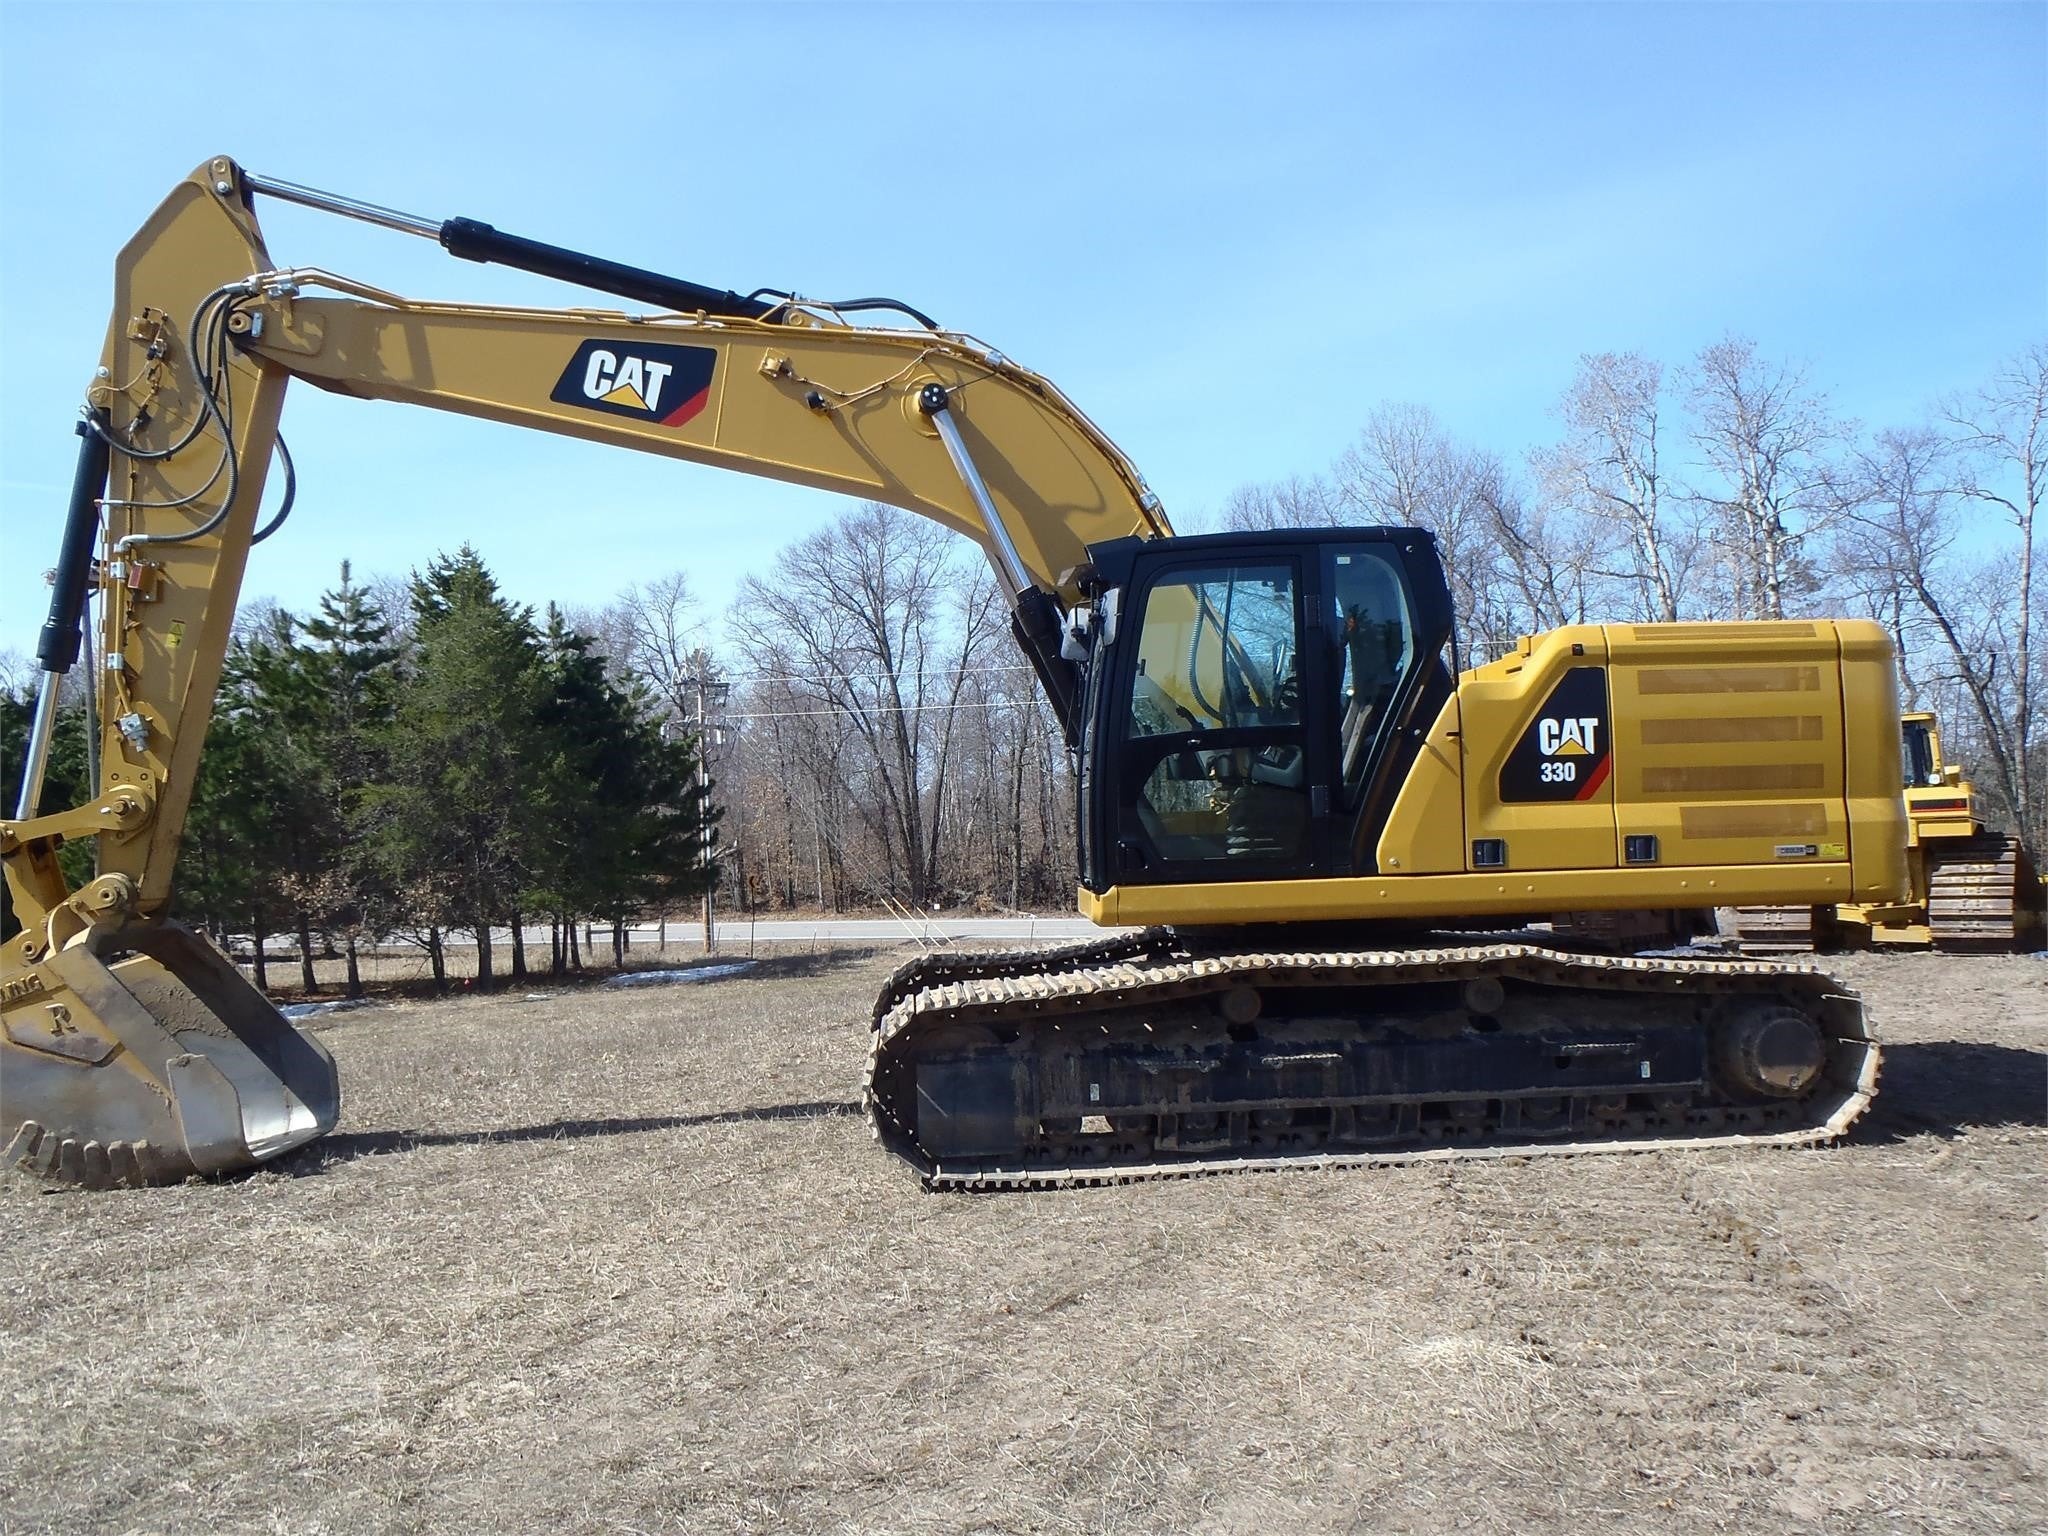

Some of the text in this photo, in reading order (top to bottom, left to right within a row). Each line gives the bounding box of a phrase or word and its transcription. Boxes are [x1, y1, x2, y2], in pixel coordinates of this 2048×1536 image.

[583, 349, 673, 412] CAT
[1538, 717, 1599, 756] CAT
[1541, 762, 1576, 782] 330
